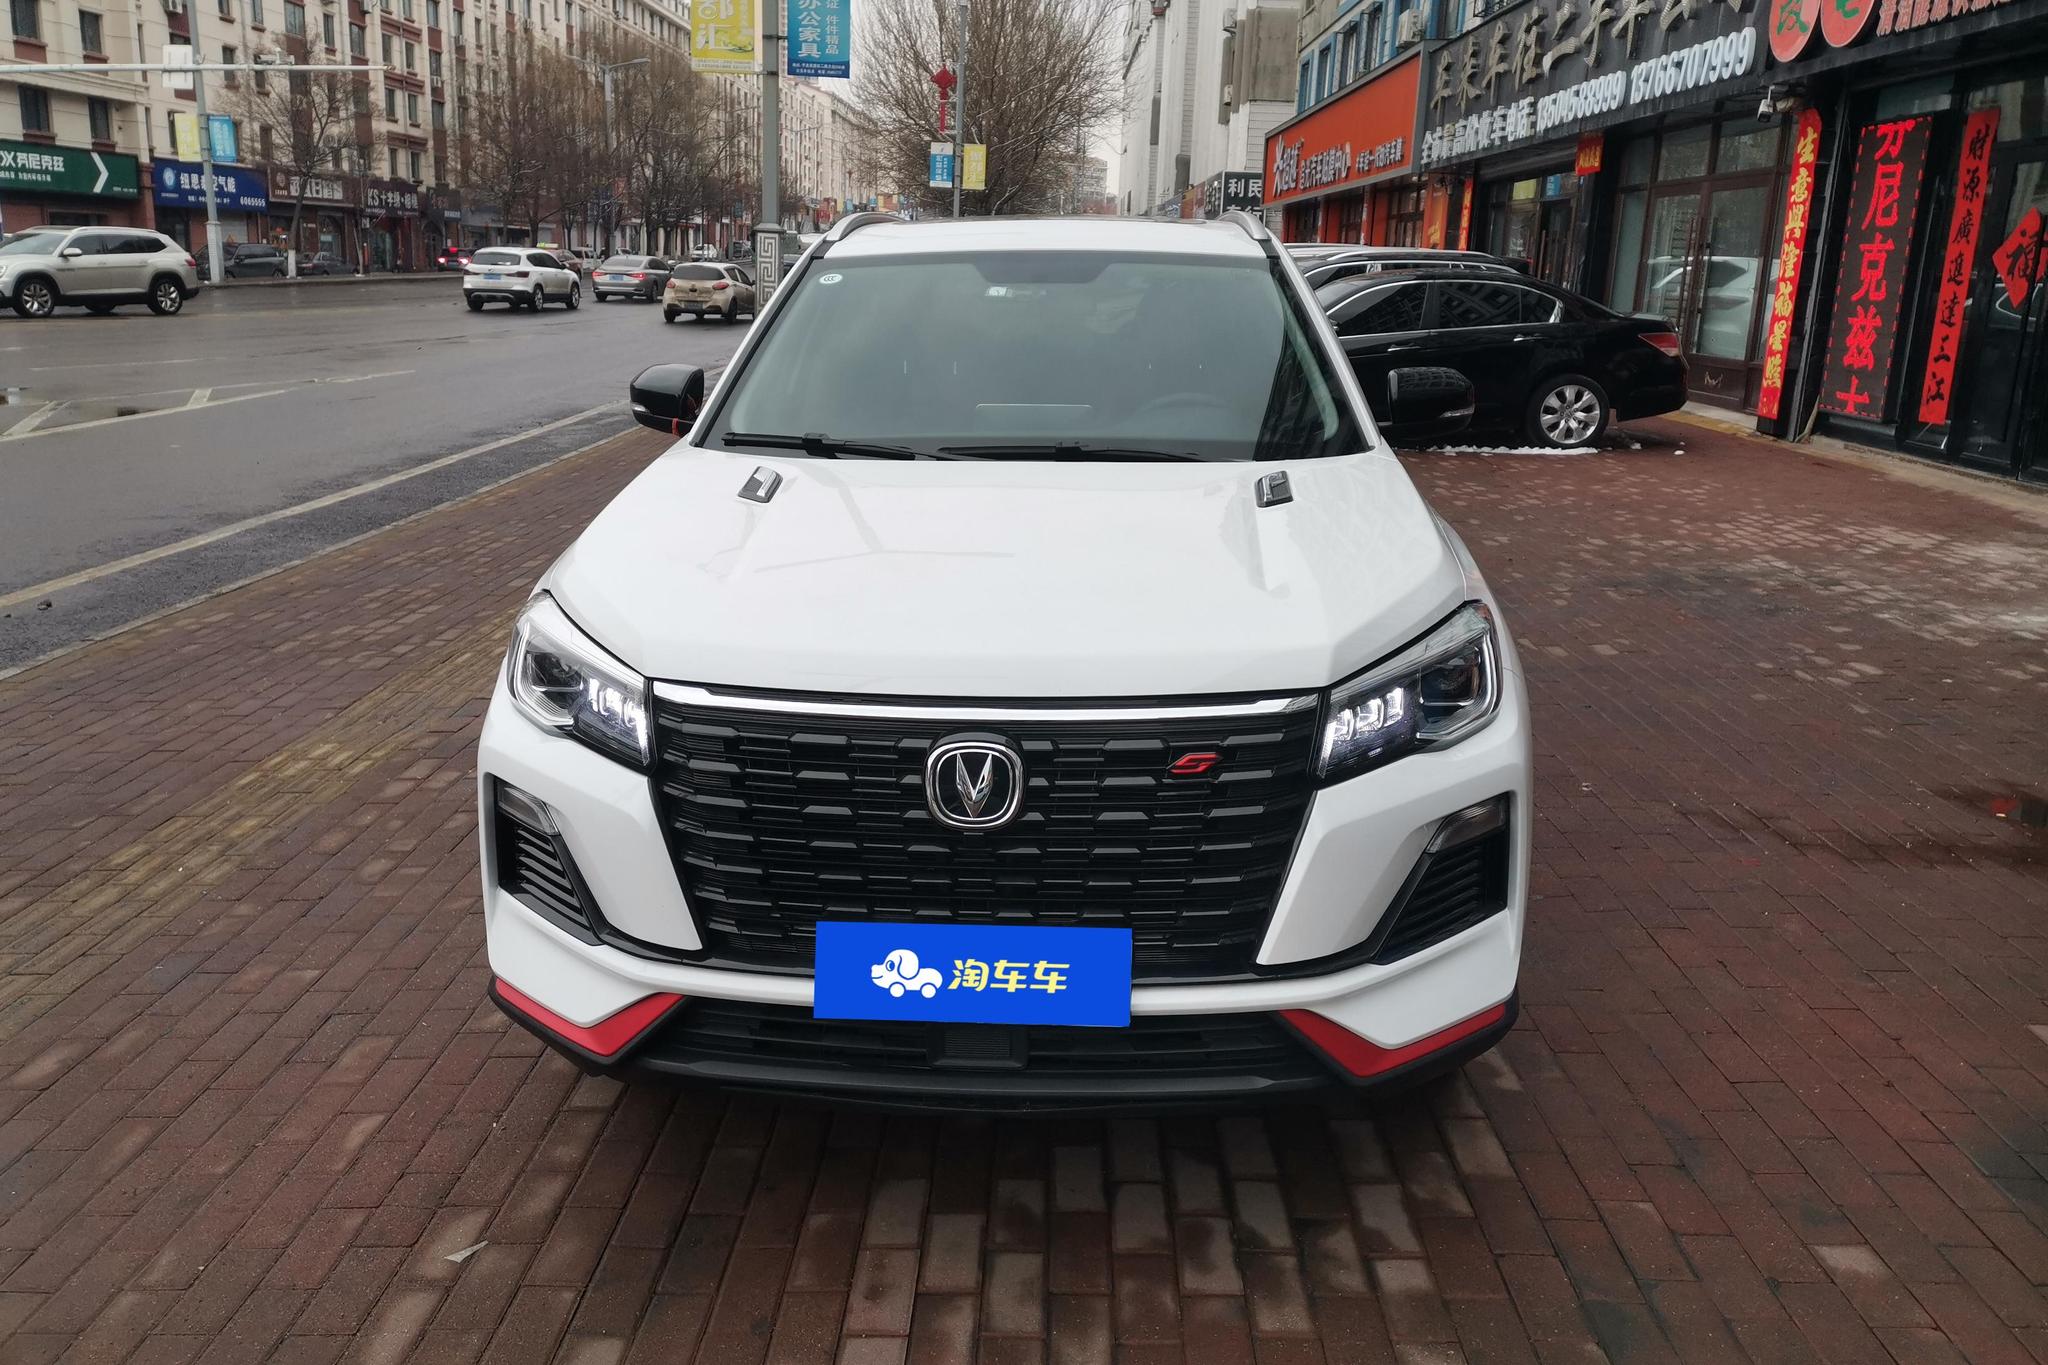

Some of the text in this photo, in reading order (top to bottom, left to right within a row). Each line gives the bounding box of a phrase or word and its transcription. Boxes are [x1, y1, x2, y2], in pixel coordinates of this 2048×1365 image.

[799, 0, 821, 58] 办公家具
[1537, 71, 1627, 133] 13504588999
[1630, 27, 1757, 105] 13766707999
[1228, 178, 1261, 198] 利民
